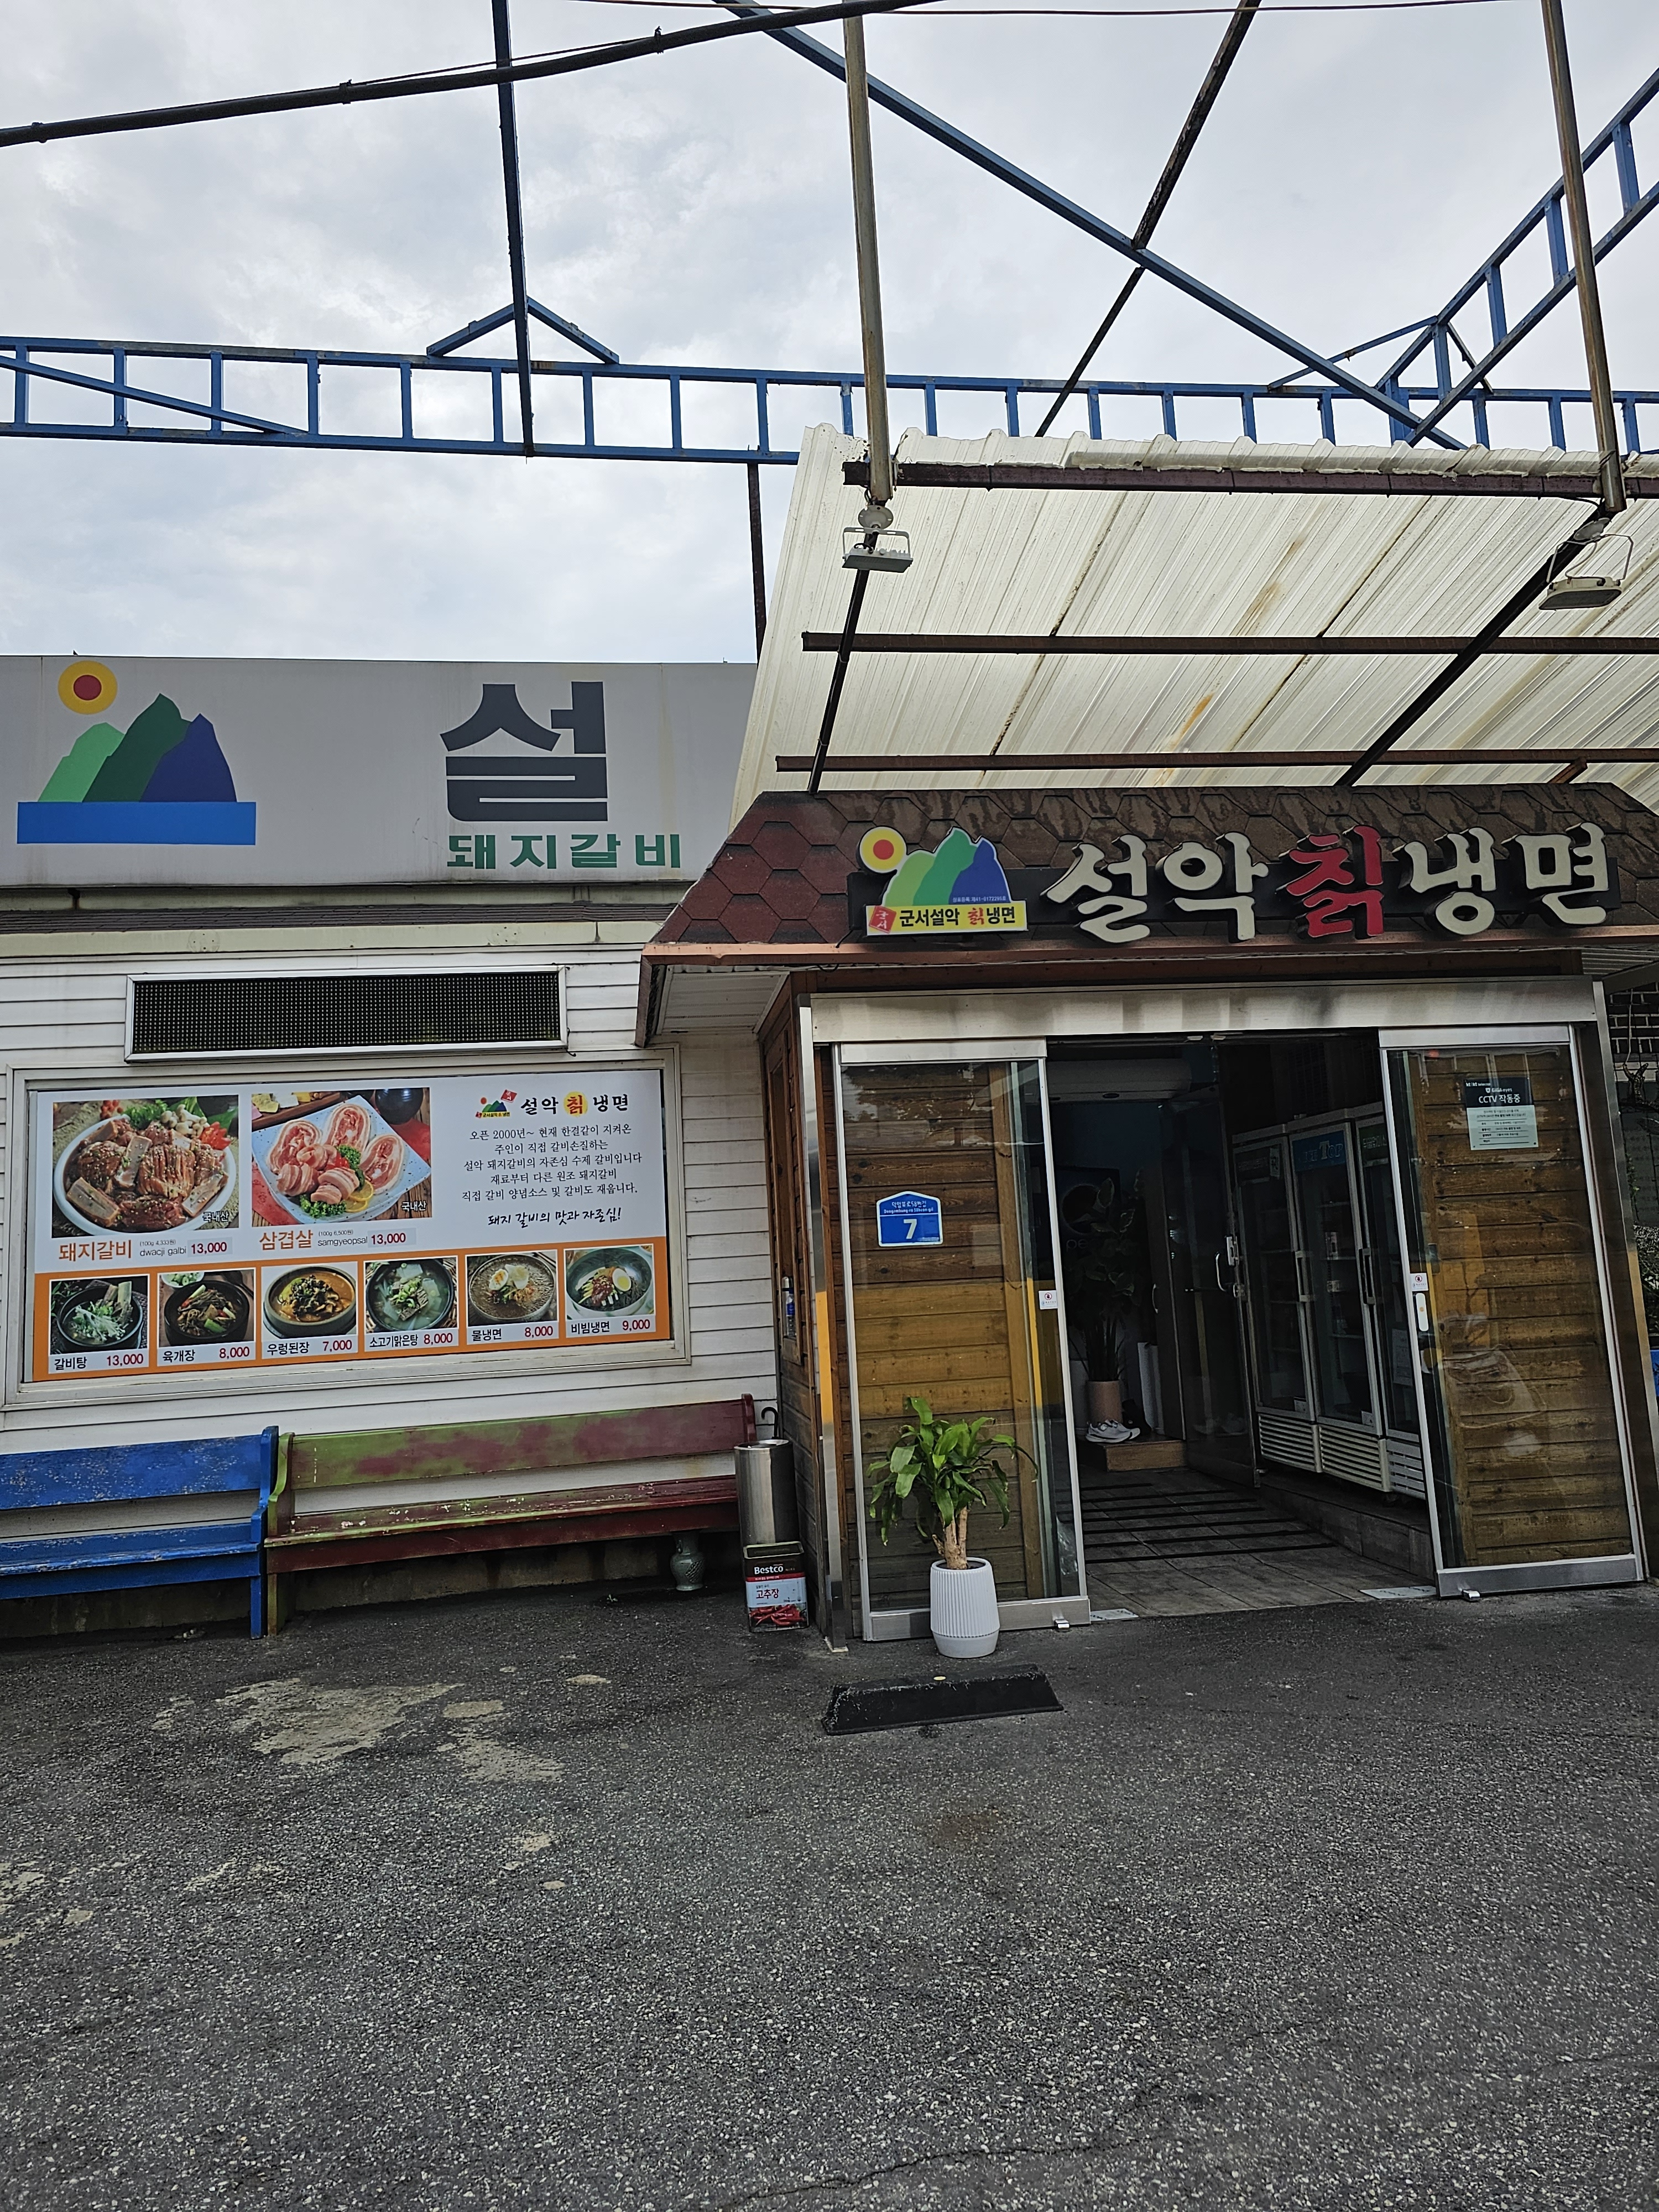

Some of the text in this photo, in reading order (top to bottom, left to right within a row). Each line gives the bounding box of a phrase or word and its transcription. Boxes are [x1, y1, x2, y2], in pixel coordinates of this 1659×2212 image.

[440, 681, 608, 822] 설
[446, 833, 682, 870] 돼지갈비
[899, 908, 960, 927] 군서설악
[520, 1093, 628, 1115] 설악 칡 냉면
[1479, 1094, 1521, 1103] CCTV 작동중
[469, 1130, 489, 1140] 오픈
[539, 1126, 557, 1138] 현재
[561, 1124, 599, 1137] 한결같이
[603, 1123, 632, 1135] 지켜온
[494, 1140, 608, 1155] 주인이 직접 갈비손질하는
[463, 1152, 642, 1171] 설악 돼지갈비의 자존심 수제 갈비입니다
[491, 1168, 617, 1185] 재료부터 다른 원조 돼지갈비
[462, 1182, 638, 1202] 직접 갈비 양념소스 및 갈비도 재웁니다.
[401, 1200, 427, 1212] 국내산
[202, 1211, 228, 1223] 국내산
[488, 1207, 622, 1228] 돼지 갈비의 맛과 자존심!
[903, 1218, 917, 1239] 7
[259, 1229, 313, 1250] 삼겹살
[317, 1236, 368, 1248] samgyeopsal
[371, 1232, 406, 1245] 13,000
[59, 1239, 132, 1261] 돼지갈비
[140, 1246, 186, 1256] dwacji galbi
[191, 1241, 227, 1255] 13,000
[524, 1326, 554, 1338] 8,000
[570, 1321, 610, 1334] 비빔냉면
[622, 1318, 650, 1332] 9,000
[369, 1333, 418, 1348] 소고기맑은탕
[423, 1332, 453, 1345] 8,000
[471, 1328, 502, 1342] 물냉면
[219, 1346, 250, 1360] 8,000
[267, 1341, 309, 1355] 우렁된장
[322, 1339, 352, 1353] 7,000
[106, 1353, 144, 1367] 13,000
[162, 1348, 196, 1363] 육개장
[54, 1355, 87, 1371] 갈비탕
[754, 1566, 784, 1575] Bestco
[756, 1588, 779, 1599] 고추장
